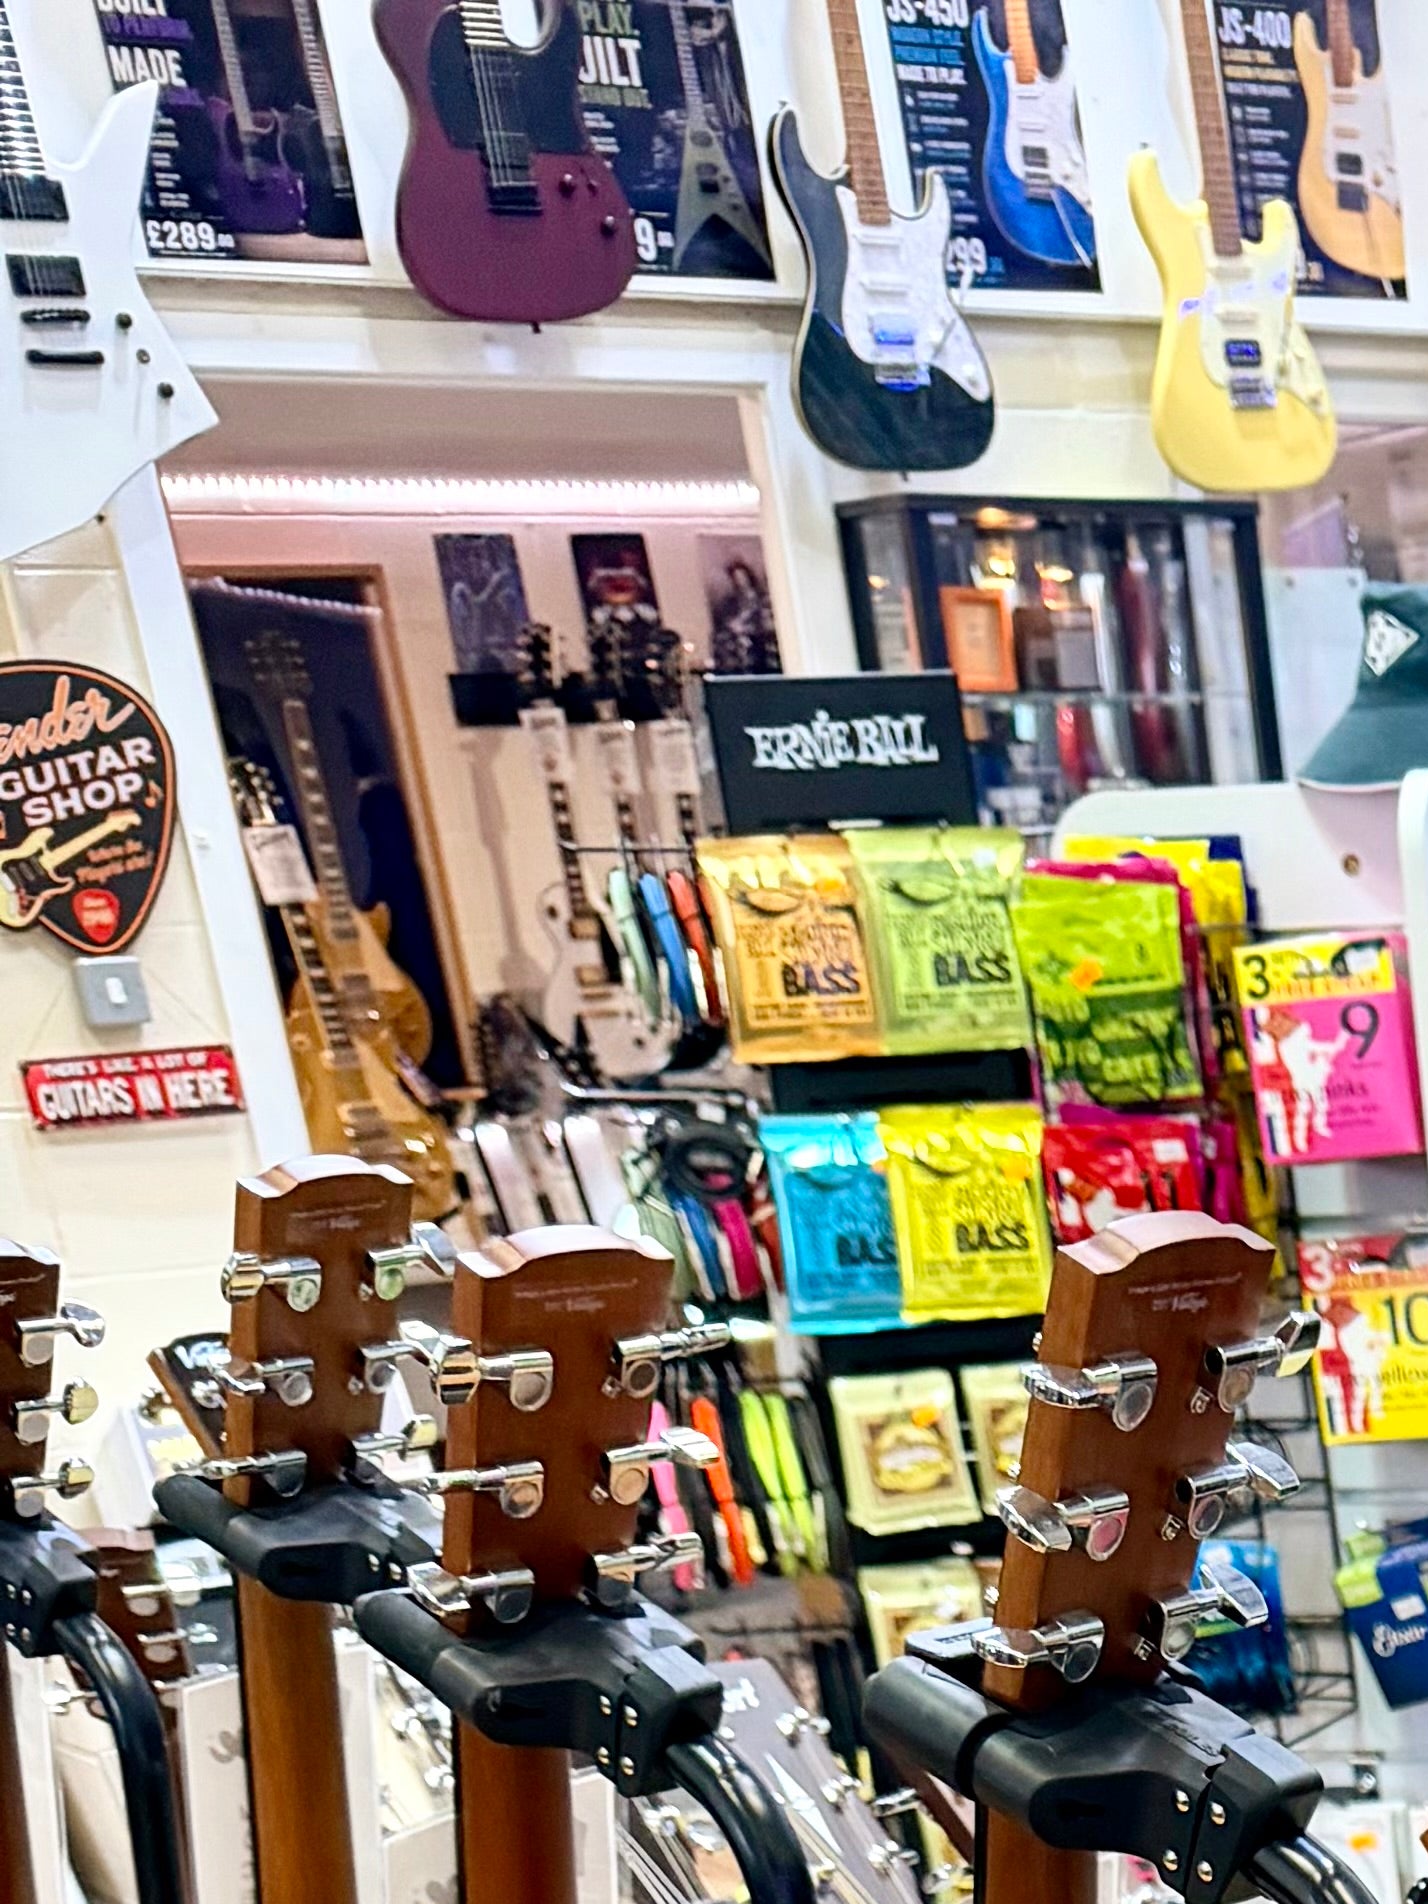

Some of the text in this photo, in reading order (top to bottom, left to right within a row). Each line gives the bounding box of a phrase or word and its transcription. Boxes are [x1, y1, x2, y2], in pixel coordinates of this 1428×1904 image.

[1219, 6, 1292, 49] JS-400
[107, 45, 188, 88] MADE
[0, 674, 137, 766] ender
[744, 710, 942, 773] ERNIE BALL
[0, 736, 157, 801] GUITAR
[22, 772, 144, 828] SHOP
[781, 961, 861, 998] BASS
[934, 952, 1012, 988] BASS
[1242, 954, 1270, 999] 3
[1340, 1001, 1379, 1060] 9
[37, 1068, 235, 1121] GUITARS IN HERE
[956, 1221, 1031, 1254] BASS
[1303, 1247, 1337, 1293] 3
